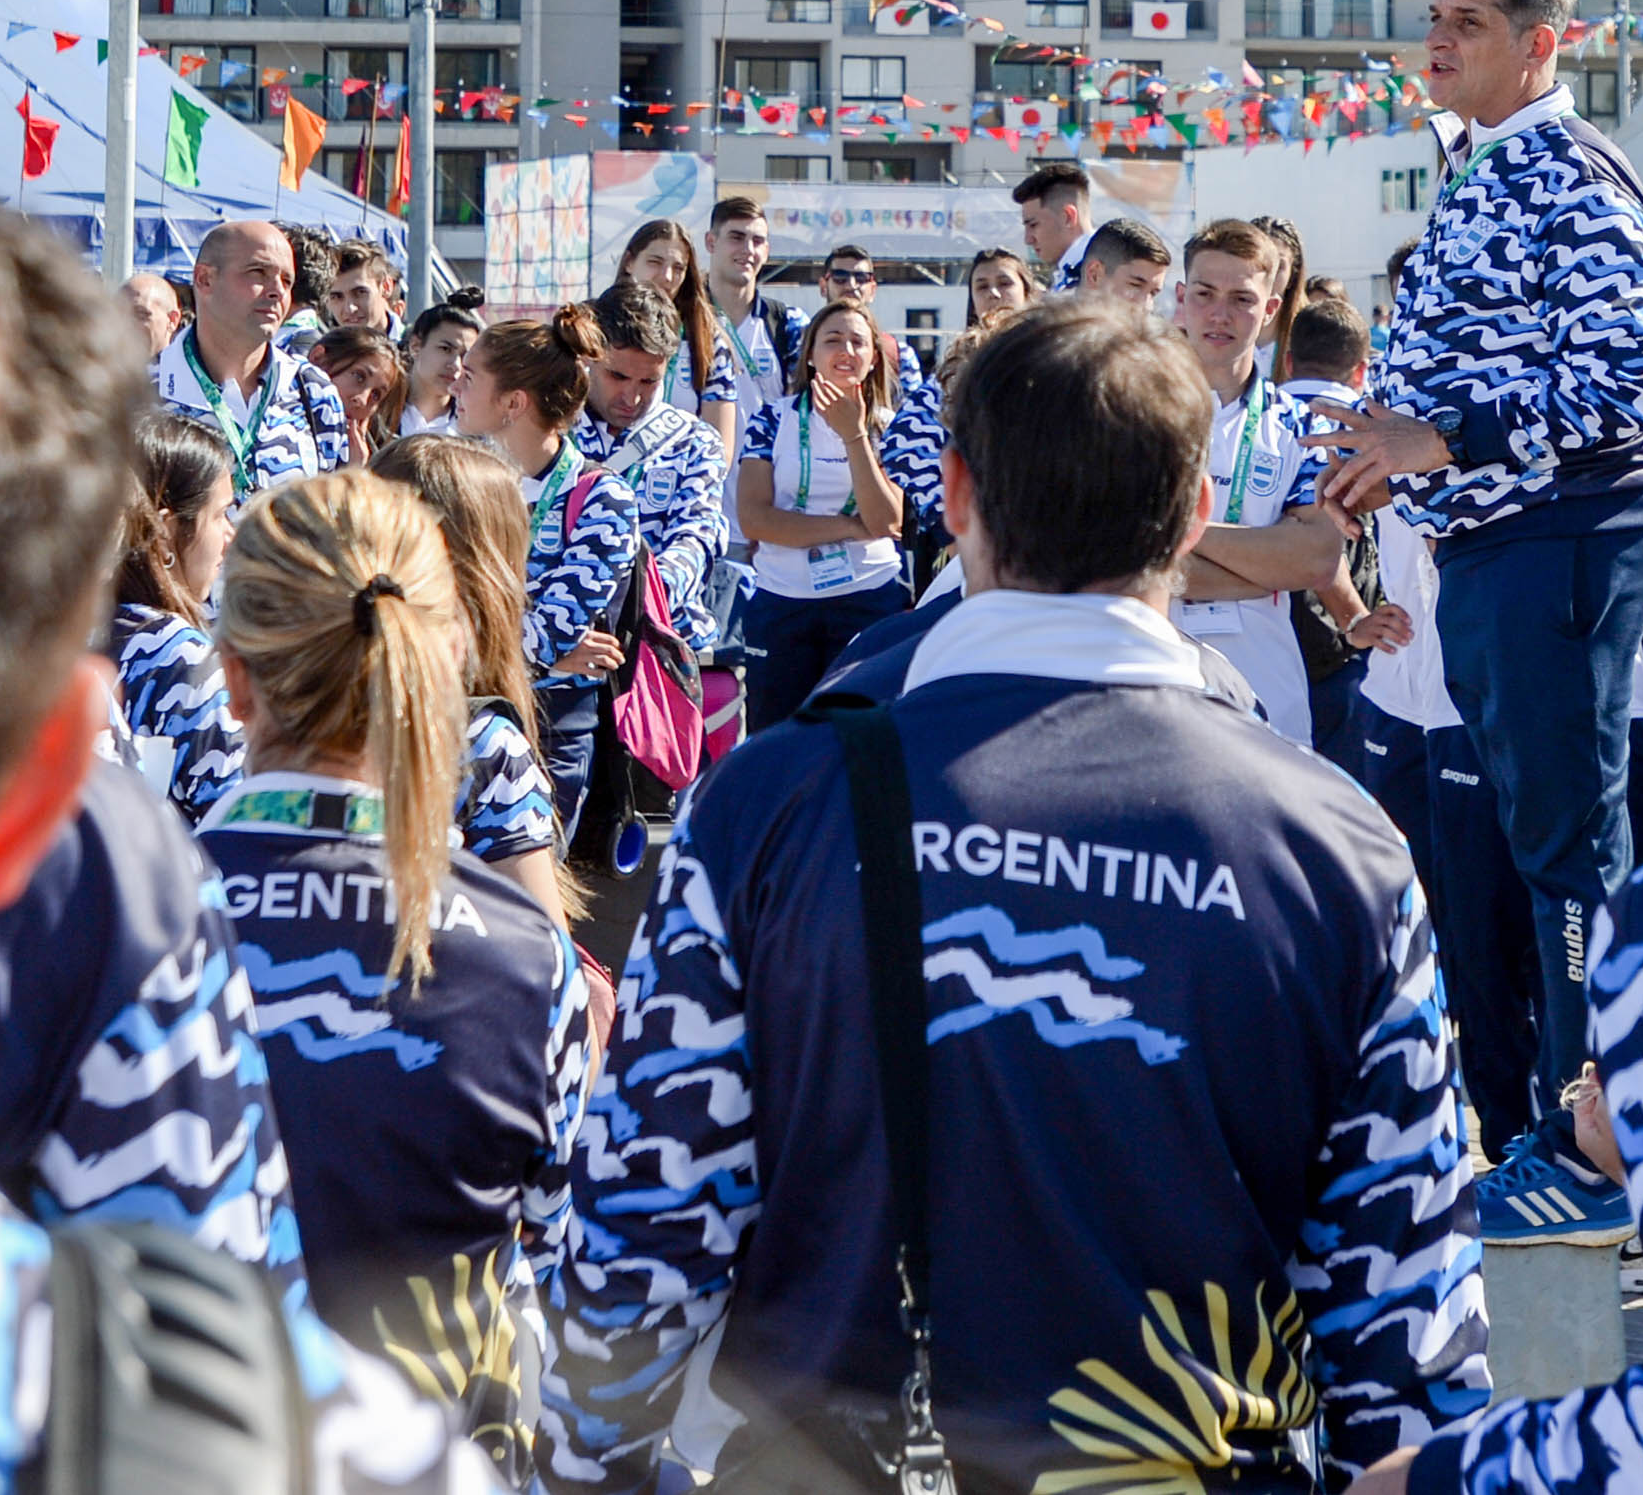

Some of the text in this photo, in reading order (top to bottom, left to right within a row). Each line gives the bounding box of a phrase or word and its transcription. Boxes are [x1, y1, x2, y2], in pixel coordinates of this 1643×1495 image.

[773, 208, 854, 228] BUENOS
[639, 410, 684, 451] ARG
[911, 821, 1246, 921] RGENTINA
